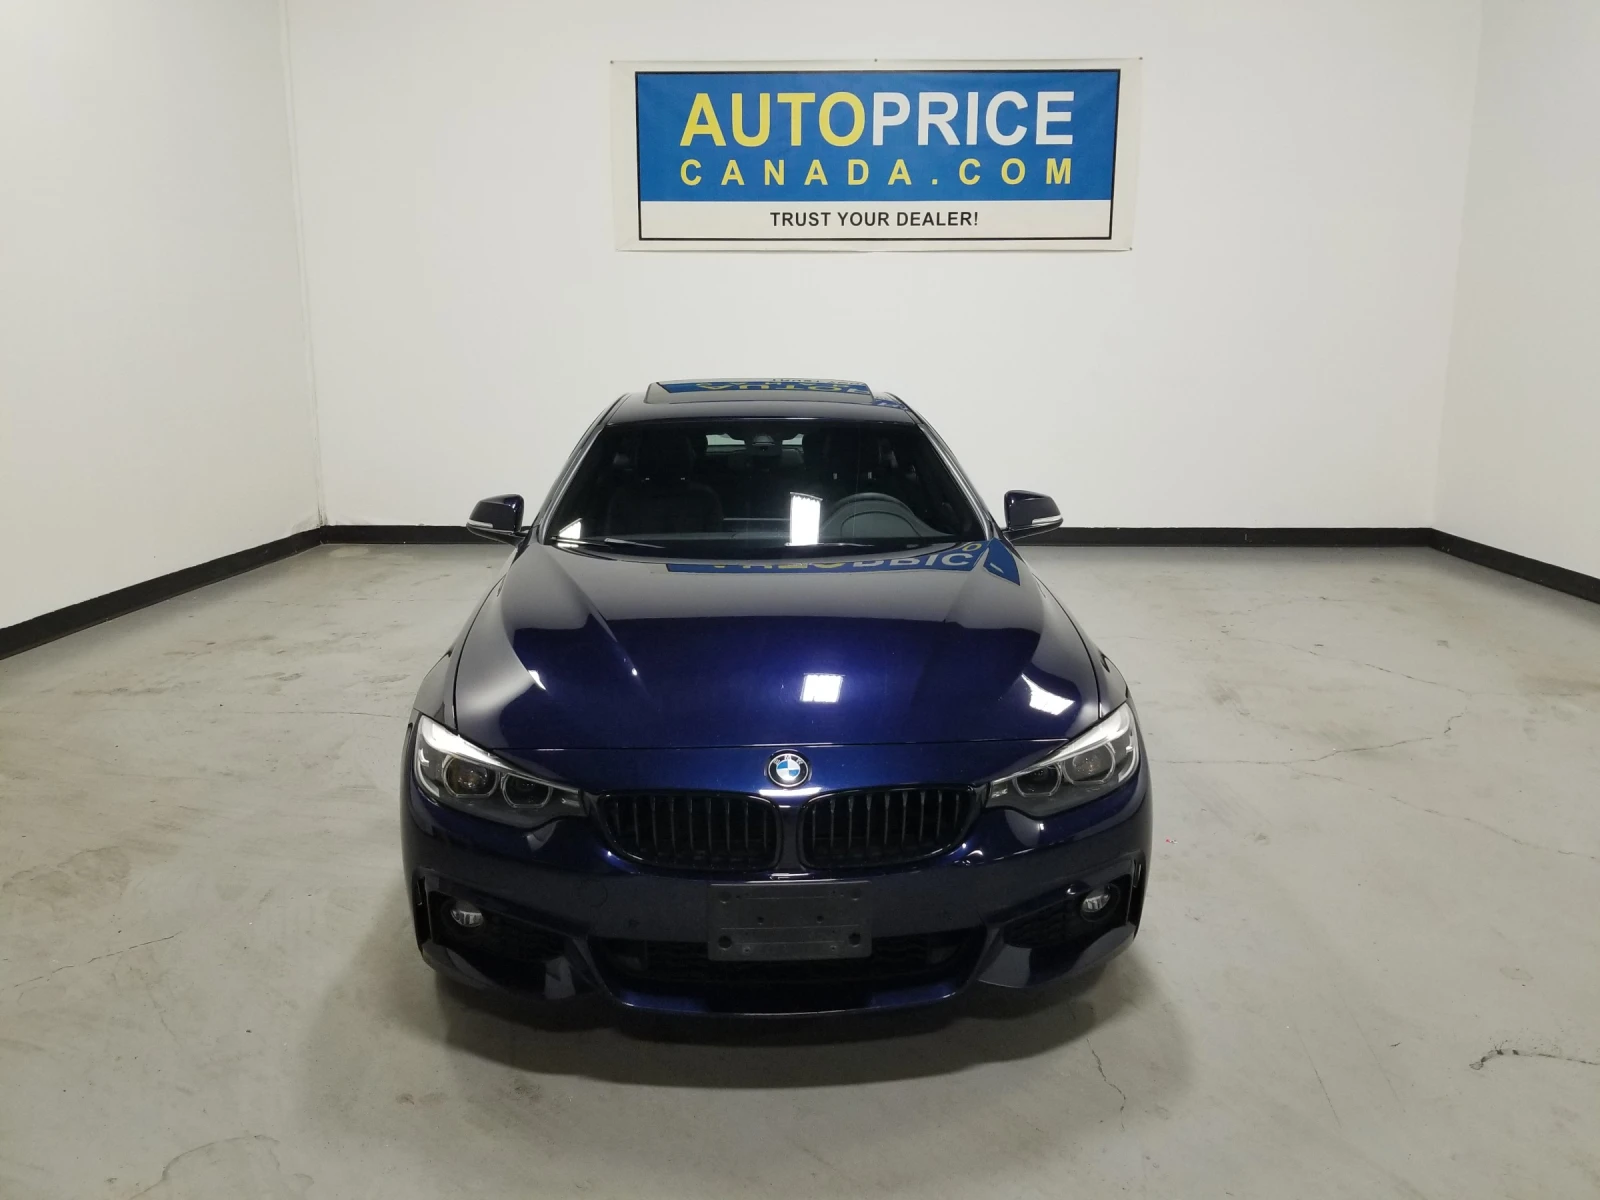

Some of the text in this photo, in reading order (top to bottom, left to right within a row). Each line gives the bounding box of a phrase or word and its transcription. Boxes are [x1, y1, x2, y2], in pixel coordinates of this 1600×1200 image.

[679, 90, 1075, 148] AUTOPRICE
[680, 157, 1072, 187] CANADA.COM
[769, 210, 978, 227] TRUST YOUR DEALER!
